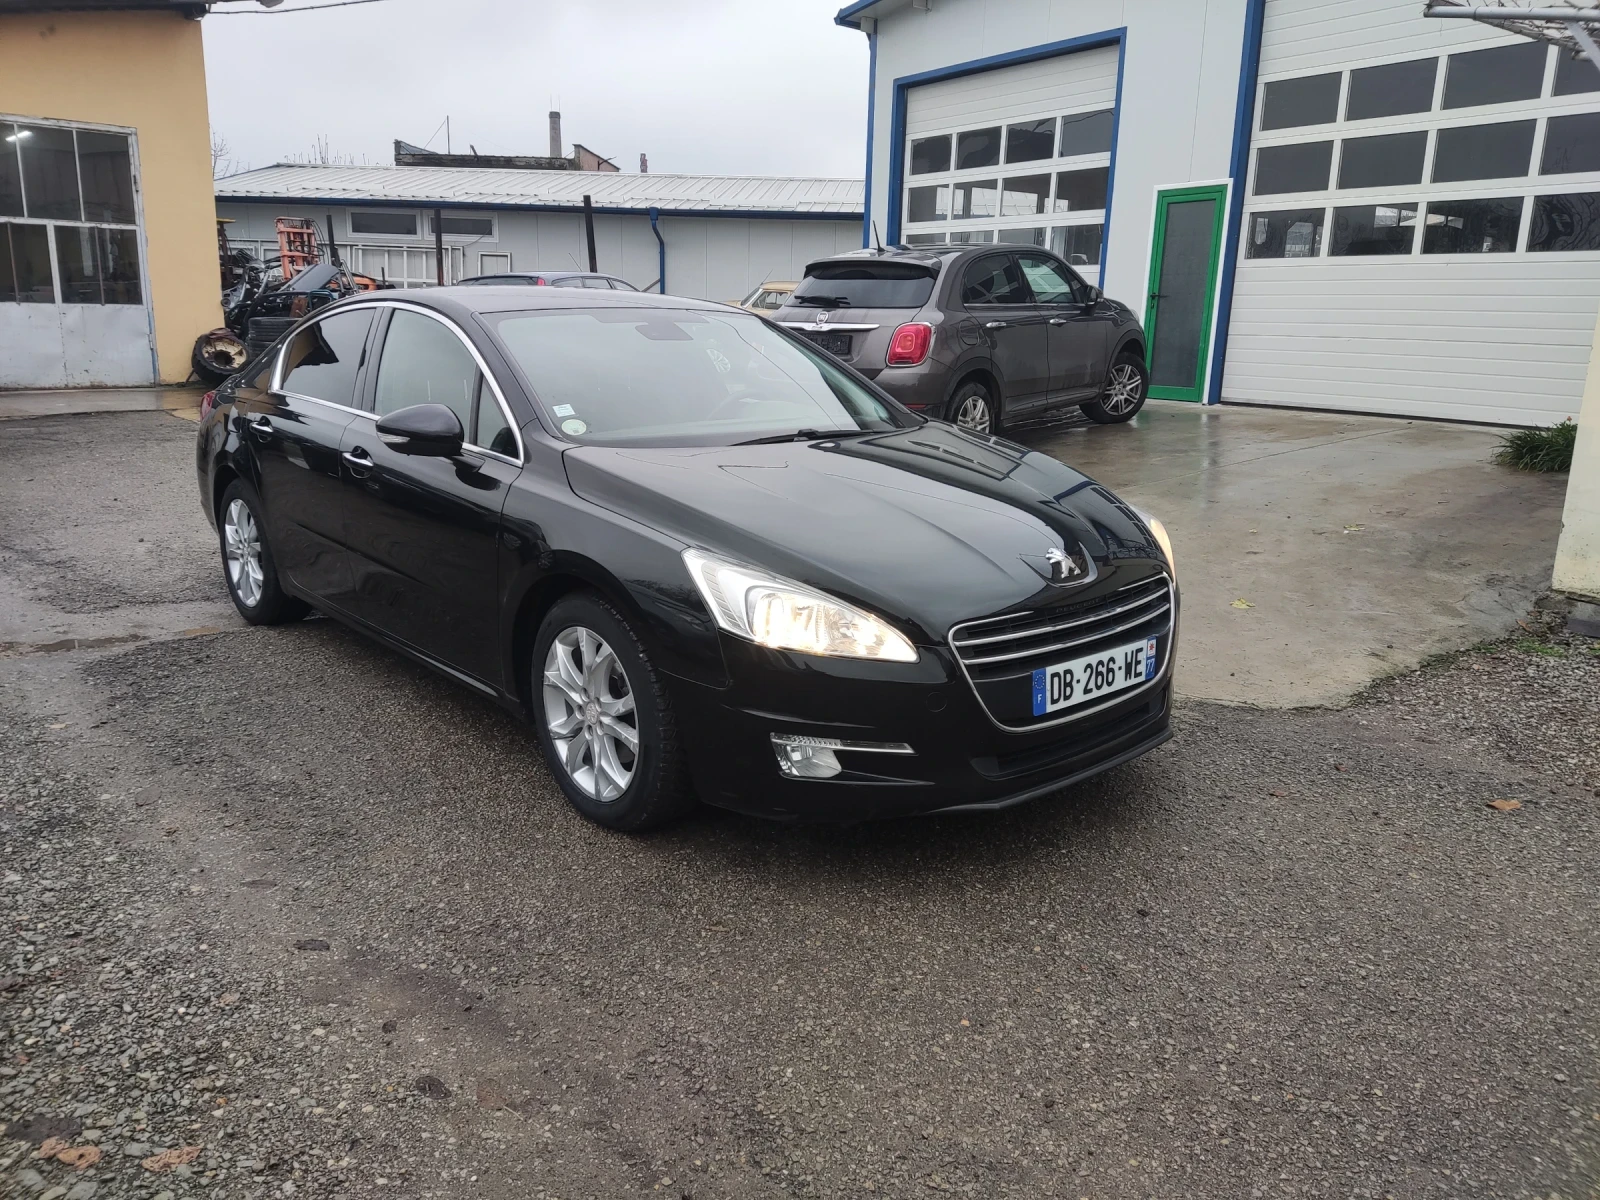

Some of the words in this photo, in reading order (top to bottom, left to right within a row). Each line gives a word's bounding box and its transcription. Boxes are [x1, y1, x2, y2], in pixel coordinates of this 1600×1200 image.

[1056, 598, 1100, 613] PEUGEOT
[1146, 658, 1155, 674] 77
[1050, 647, 1144, 705] DB-266-WE
[1037, 694, 1043, 704] F
